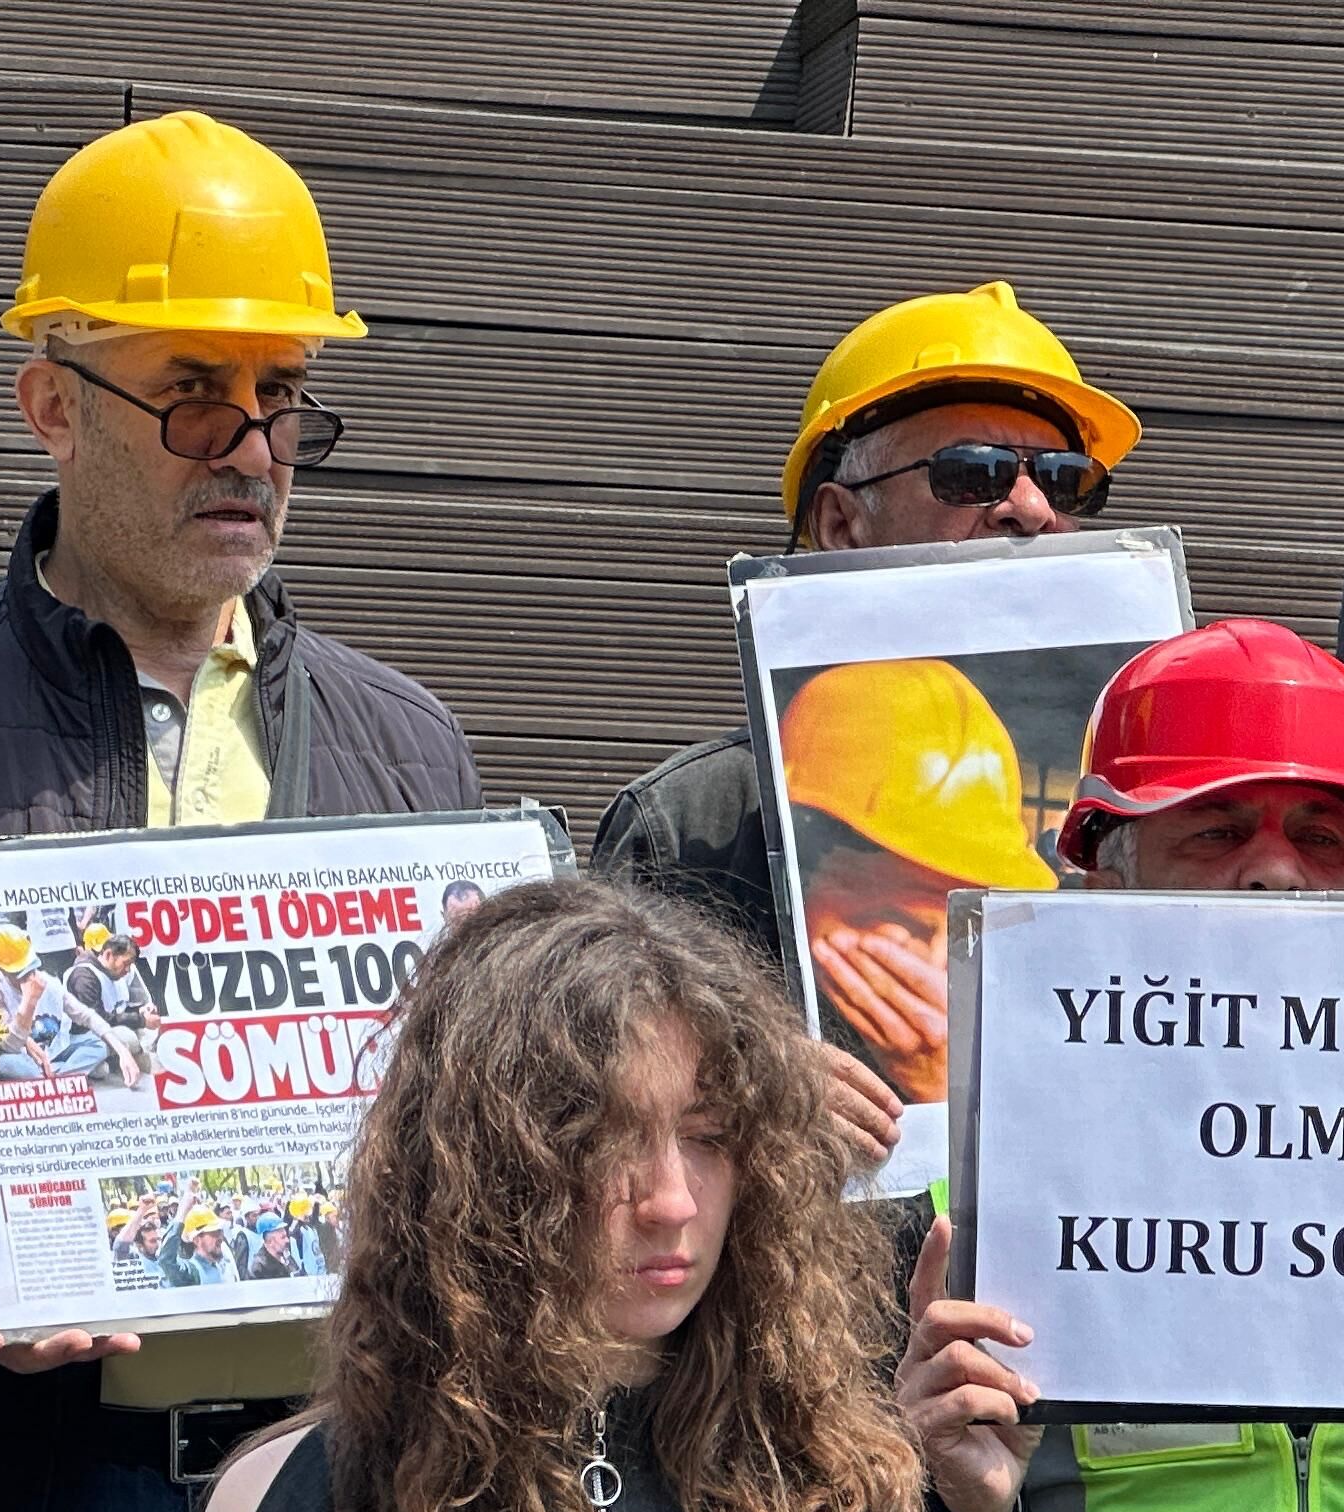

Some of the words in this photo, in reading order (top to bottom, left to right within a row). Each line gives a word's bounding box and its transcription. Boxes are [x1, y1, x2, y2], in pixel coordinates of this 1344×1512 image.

[6, 881, 98, 906] MADENCİLİK
[102, 875, 188, 899] EMEKÇİLERİ
[191, 872, 244, 893] BUGÜN
[248, 871, 311, 890] HAKLARI
[314, 867, 344, 889] İÇİN
[347, 862, 434, 885] BAKANLIĞA
[435, 861, 522, 880] YÜRÜYECEK
[251, 895, 273, 940] 1
[278, 887, 423, 938] ÖDEME
[137, 948, 325, 1017] YÜZDE
[1053, 974, 1257, 1050] YİĞİT
[157, 1015, 396, 1104] SÖMÜR
[15, 1141, 68, 1157] haklarının
[69, 1138, 113, 1155] yalnızca
[170, 1126, 240, 1144] alabildiklerini
[297, 1122, 318, 1134] tüm
[25, 1121, 84, 1137] Madencilik
[86, 1116, 143, 1133] emekçileri
[145, 1113, 168, 1131] açlık
[171, 1108, 228, 1128] grevlerinin
[36, 1154, 124, 1171] sürdüreceklerini
[126, 1151, 153, 1165] ifade
[178, 1144, 237, 1160] Madenciler
[10, 1181, 38, 1196] HAKLI
[39, 1178, 87, 1194] MÜCADELE
[1058, 1215, 1268, 1277] KURU
